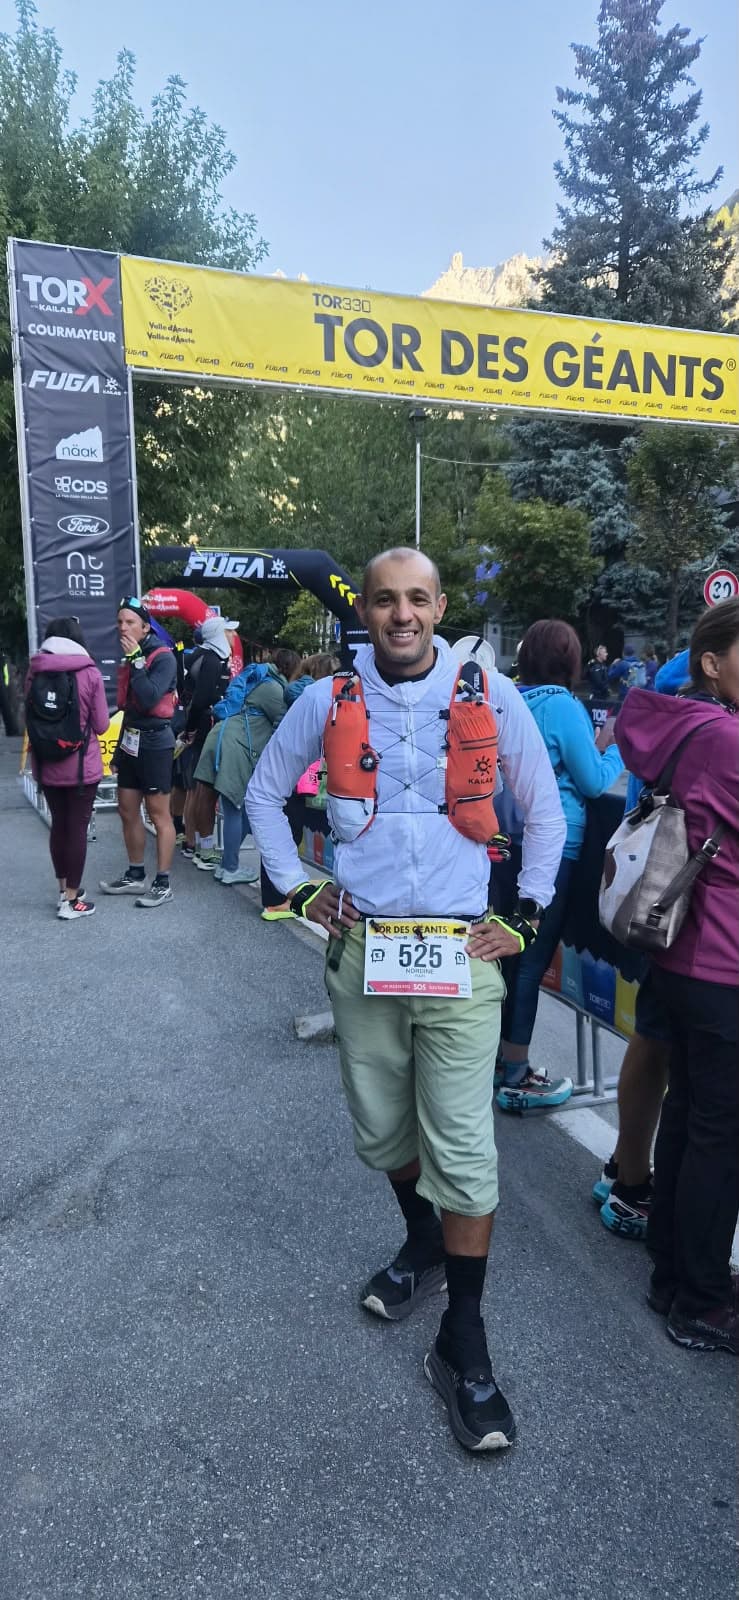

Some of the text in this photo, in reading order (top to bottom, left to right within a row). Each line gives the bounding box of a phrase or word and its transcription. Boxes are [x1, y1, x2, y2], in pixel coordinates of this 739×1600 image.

[22, 274, 114, 316] TORX
[312, 293, 371, 313] TOR330
[28, 323, 116, 343] COURMAYEUR
[314, 313, 424, 373] TOR
[441, 328, 529, 383] DES
[28, 370, 100, 394] FUGA
[62, 443, 98, 458] näak
[72, 479, 108, 495] CDS
[67, 517, 100, 534] Ford
[183, 556, 265, 578] FUGA
[712, 581, 732, 599] 30
[393, 925, 410, 934] DES
[398, 943, 442, 968] 525
[413, 983, 426, 991] SOS
